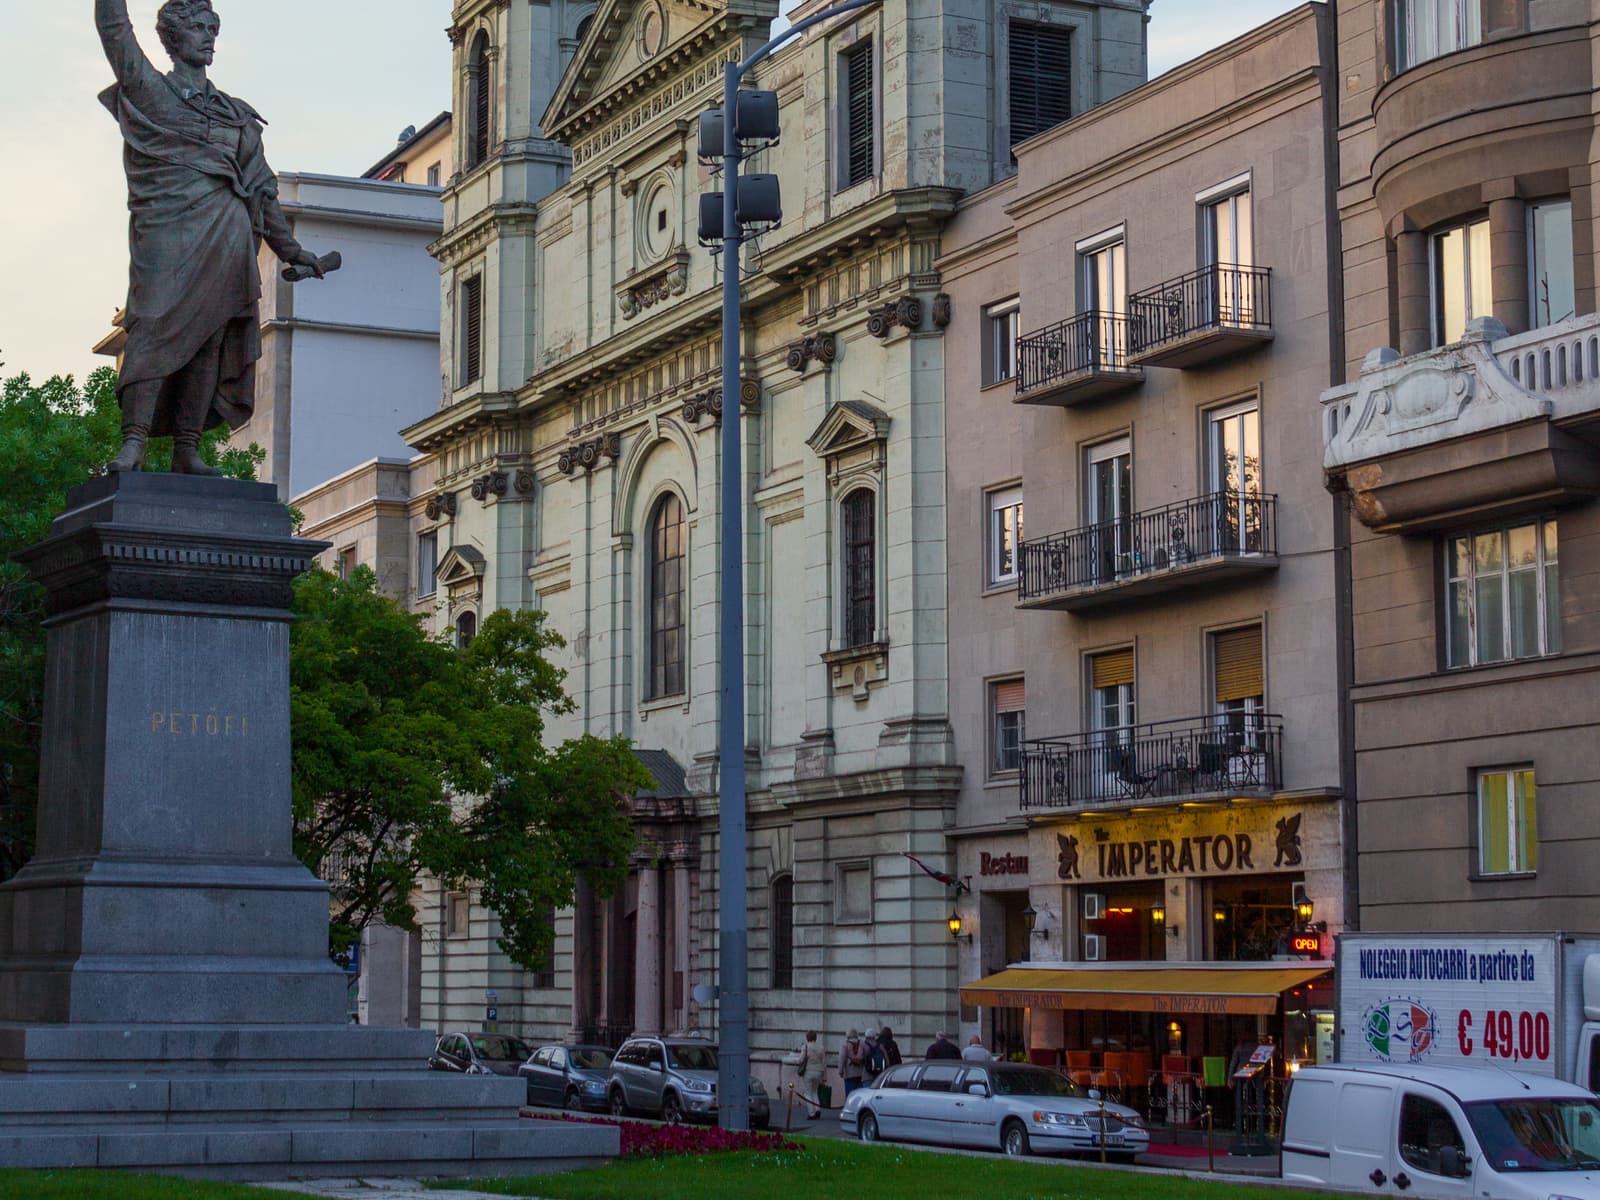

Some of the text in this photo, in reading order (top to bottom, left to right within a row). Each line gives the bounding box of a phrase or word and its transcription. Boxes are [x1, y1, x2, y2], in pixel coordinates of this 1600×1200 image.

[1098, 833, 1254, 878] IMPERATOR
[1295, 938, 1318, 951] OPEN
[1360, 948, 1535, 984] NOLEGGIO AUTOCARRI a partire da
[1170, 995, 1227, 1013] IMPERATOR
[1457, 1009, 1550, 1063] € 49,00
